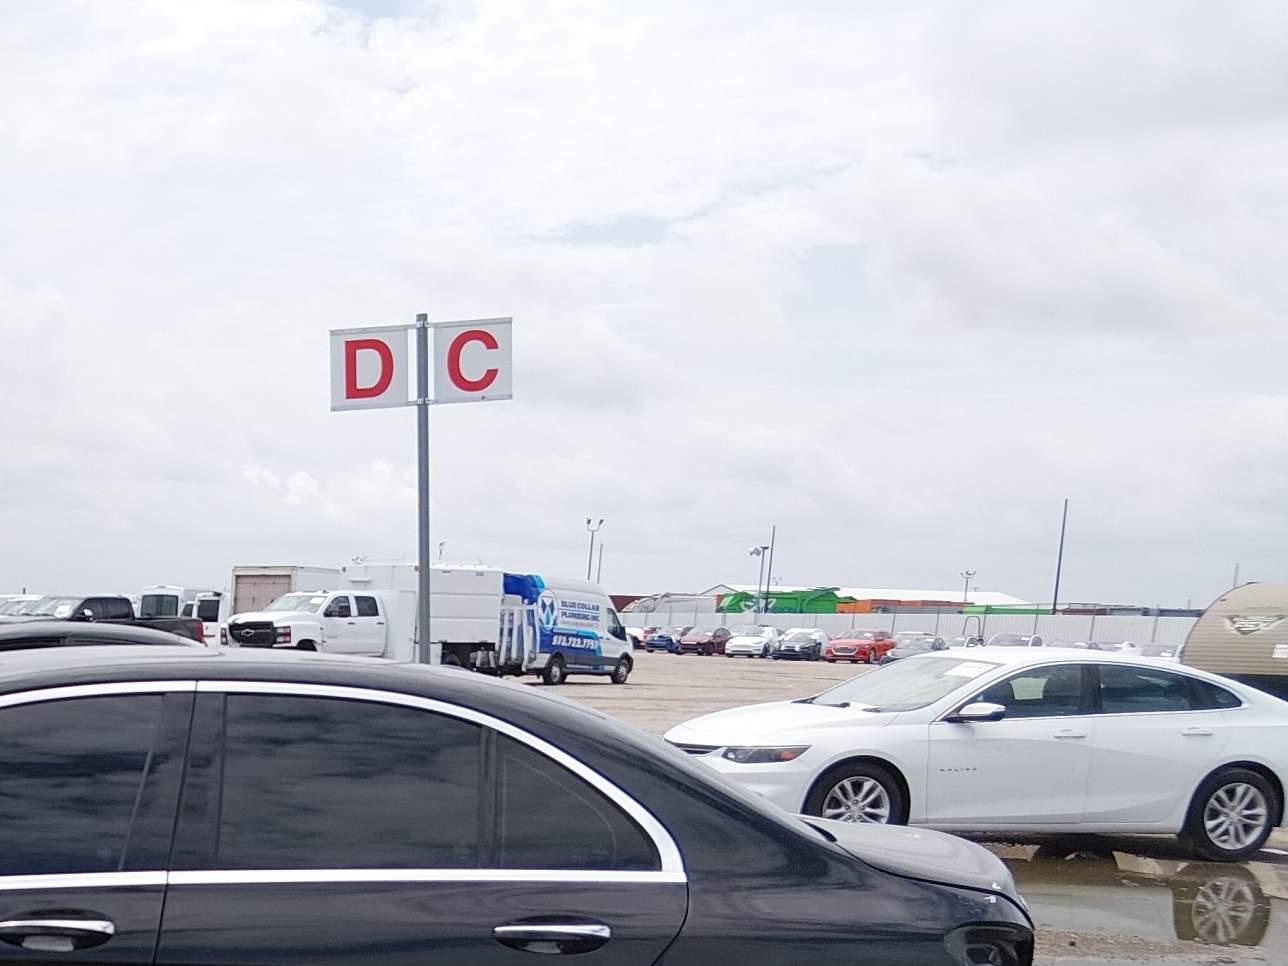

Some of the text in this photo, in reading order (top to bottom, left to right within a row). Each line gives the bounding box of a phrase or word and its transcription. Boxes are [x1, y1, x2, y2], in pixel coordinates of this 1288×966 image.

[344, 338, 394, 400] D
[447, 329, 499, 392] C
[561, 601, 600, 611] BLUE COLLAR
